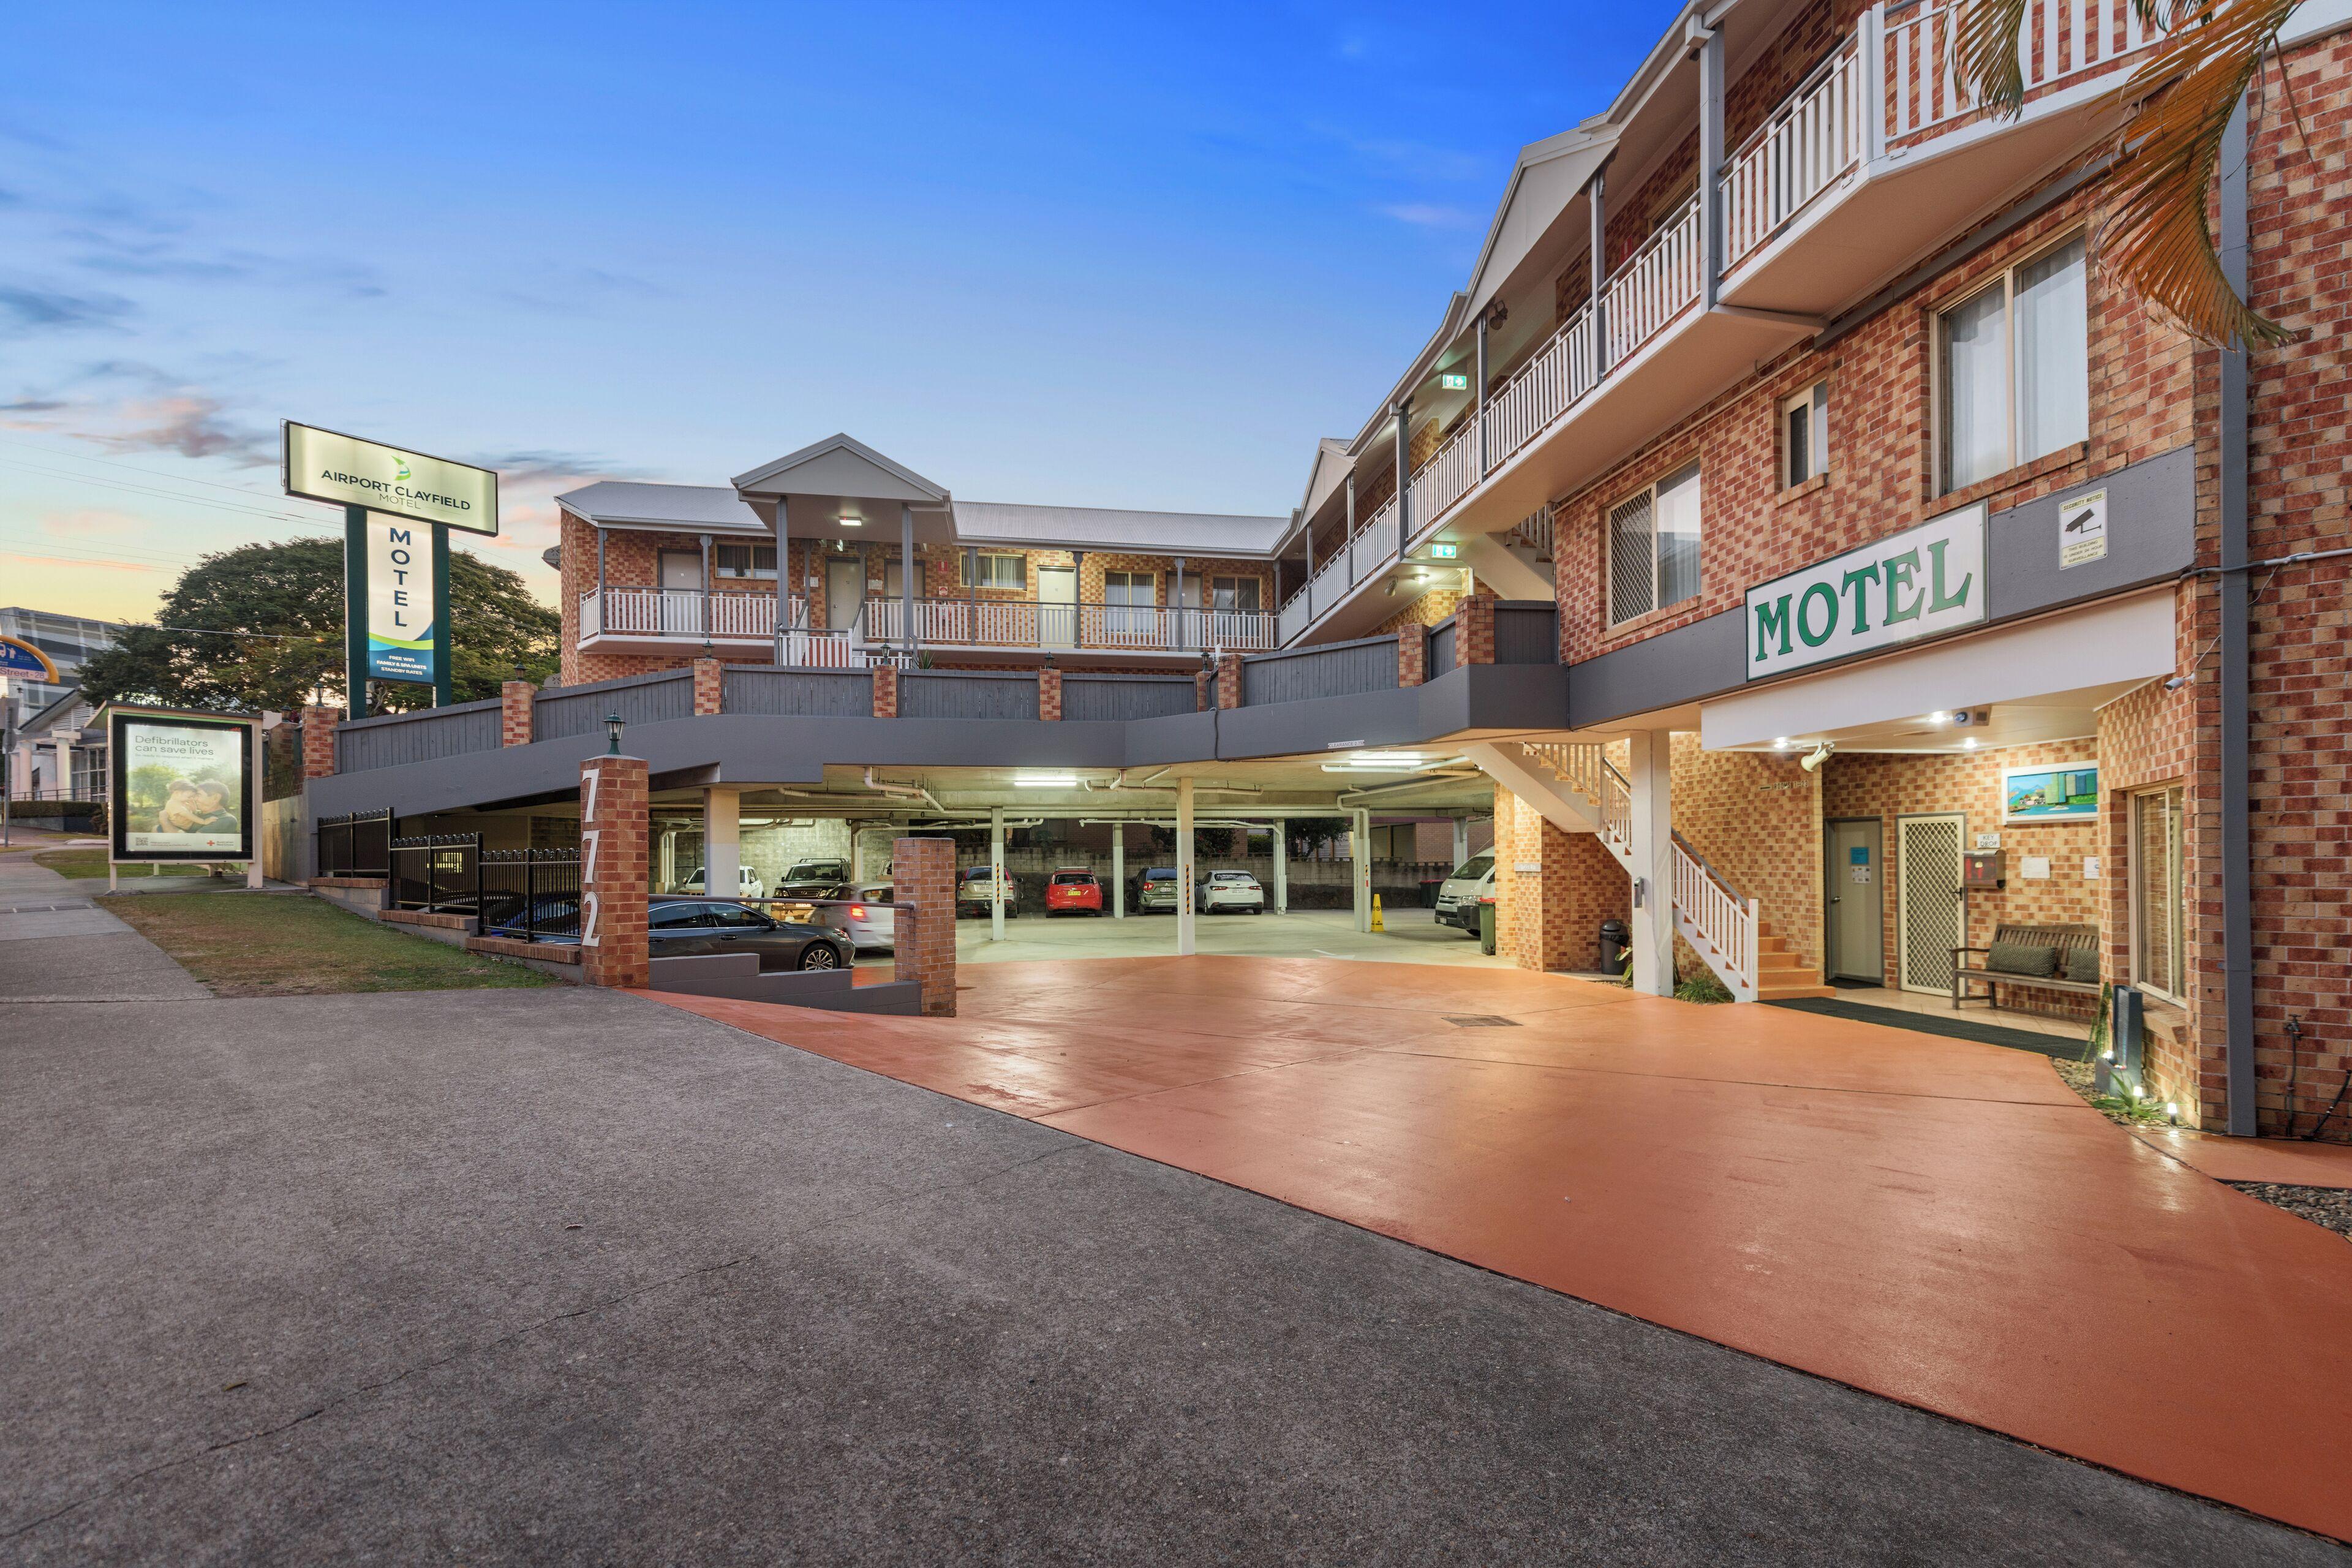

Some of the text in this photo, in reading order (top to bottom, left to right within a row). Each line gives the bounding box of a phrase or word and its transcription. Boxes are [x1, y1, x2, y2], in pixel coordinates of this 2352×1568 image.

[321, 470, 470, 510] AIRPORT CLAYFIELD
[379, 493, 421, 510] MOTEL
[2064, 493, 2103, 510] SECURITY NOTICE
[390, 527, 411, 627] MOTEL
[1755, 538, 1973, 662] MOTEL
[0, 667, 29, 677] Street
[135, 735, 209, 747] Defibrillators
[189, 746, 214, 755] lives
[582, 768, 600, 947] 772
